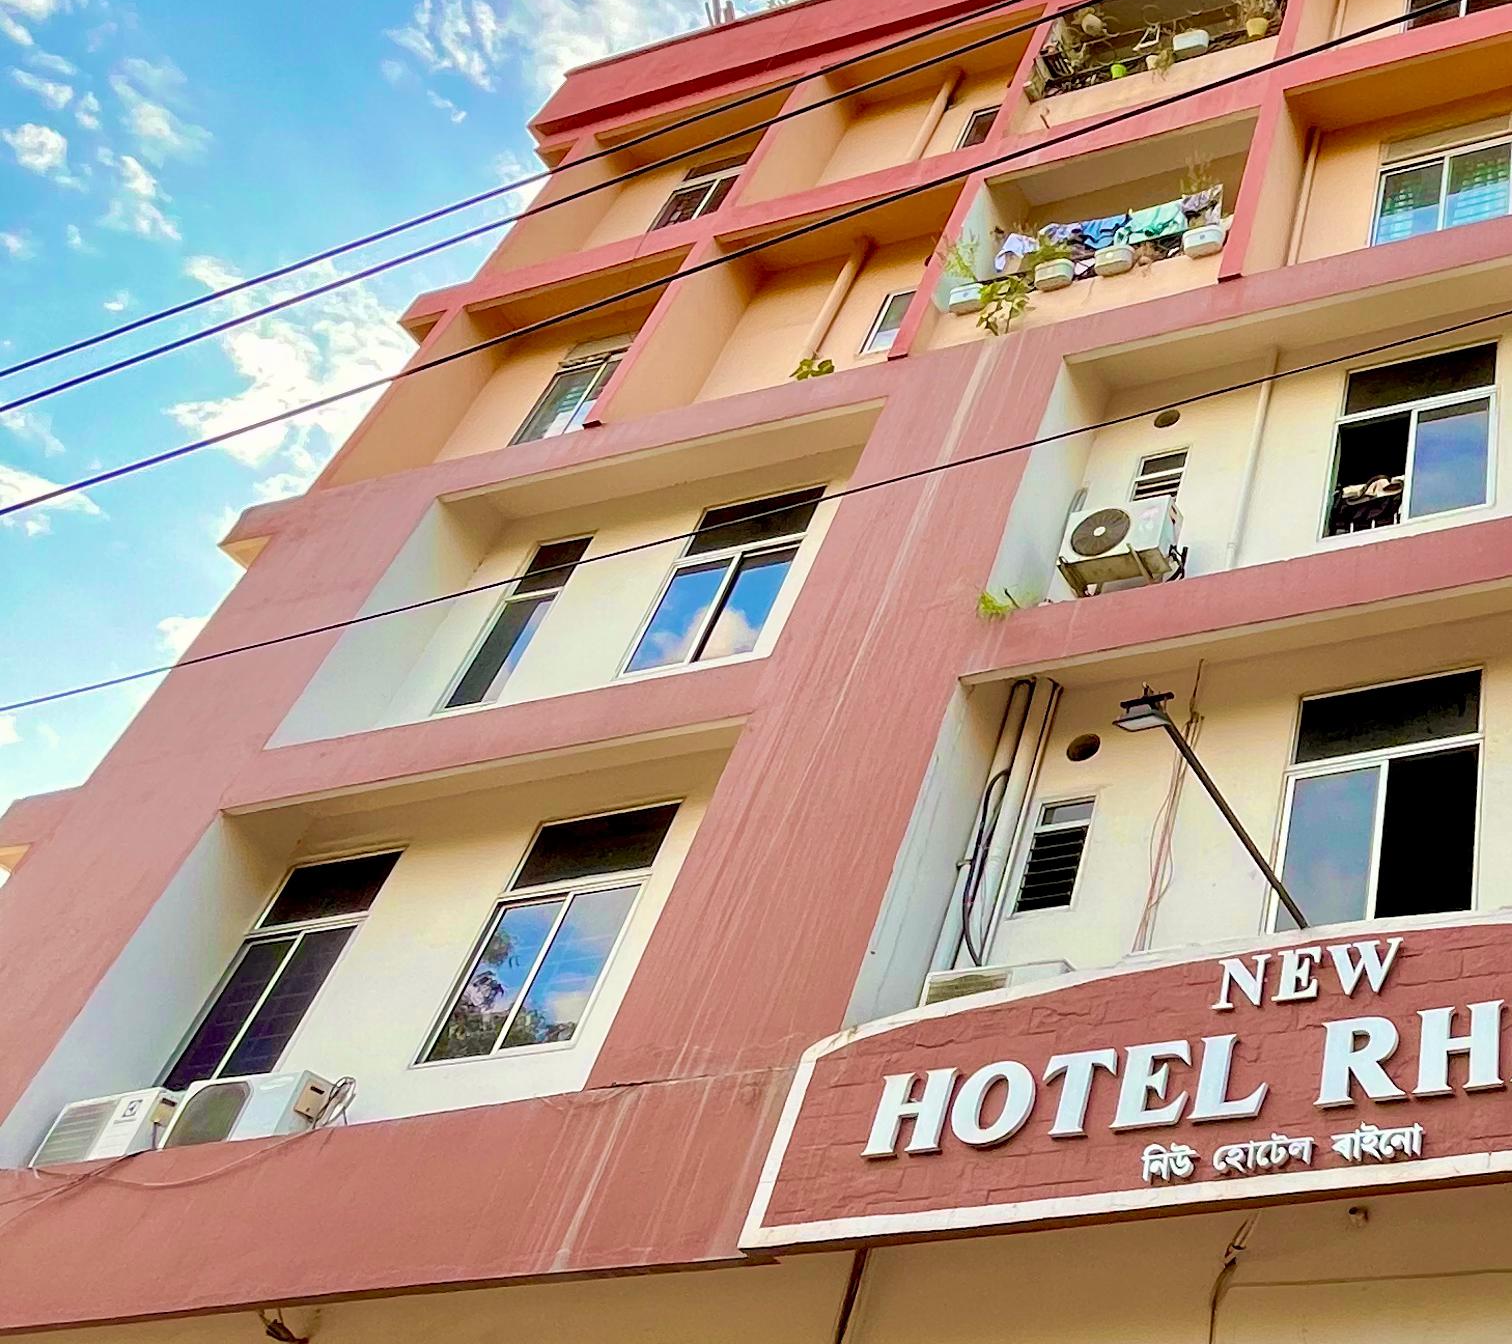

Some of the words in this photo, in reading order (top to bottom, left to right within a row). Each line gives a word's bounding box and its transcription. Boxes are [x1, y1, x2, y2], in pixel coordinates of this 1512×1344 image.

[1211, 937, 1404, 1010] NEW
[861, 1033, 1270, 1159] HOTEL
[1142, 1142, 1199, 1181] নিউ
[1213, 1132, 1315, 1173] হোটেল
